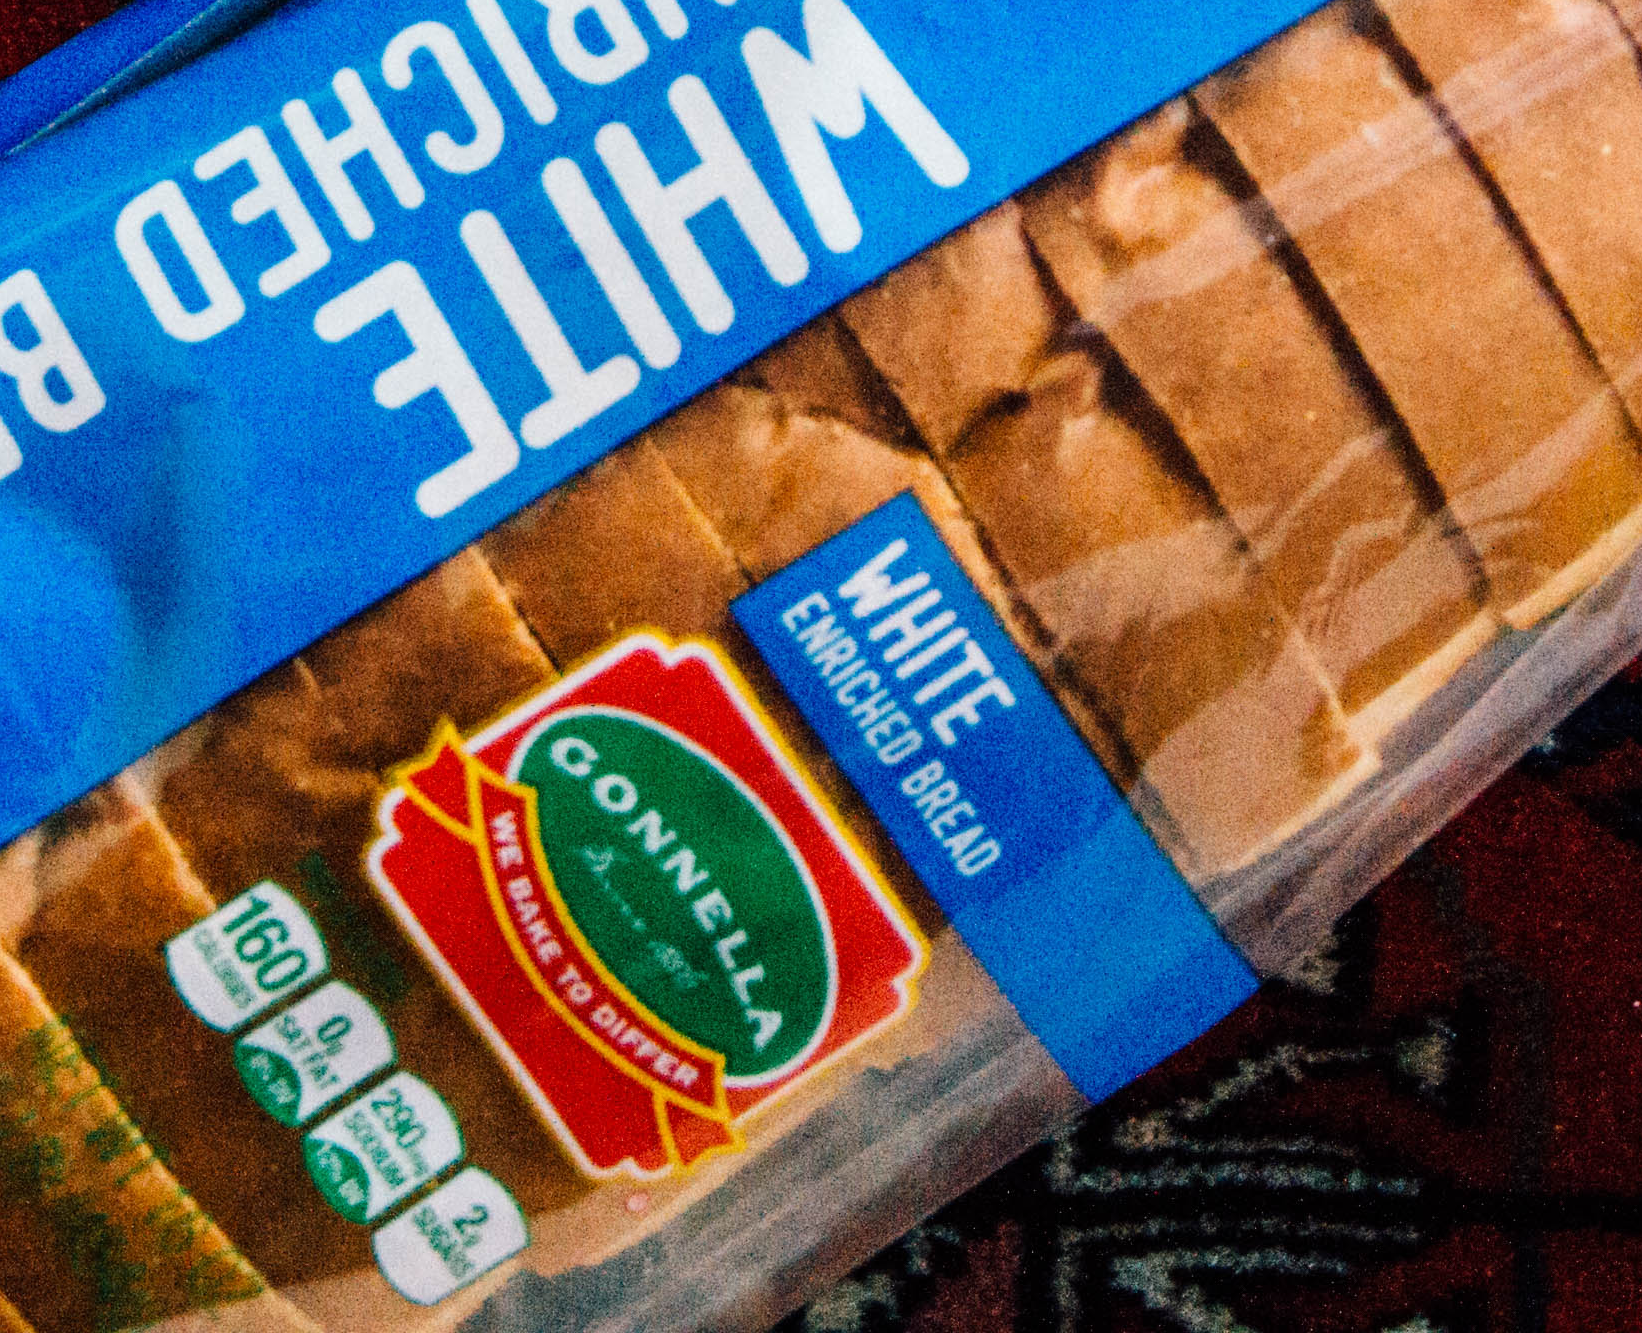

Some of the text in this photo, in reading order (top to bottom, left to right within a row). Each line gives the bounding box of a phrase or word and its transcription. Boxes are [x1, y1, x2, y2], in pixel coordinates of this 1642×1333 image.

[782, 592, 1001, 876] ENRICHED BREAD
[838, 538, 1016, 745] WHITE
[217, 891, 312, 997] 160
[491, 811, 699, 1087] WE BAKE TO DIFFER
[550, 735, 784, 1048] GONNELLA
[273, 1011, 341, 1089] SAT FAT
[342, 1107, 410, 1193] SODIUM
